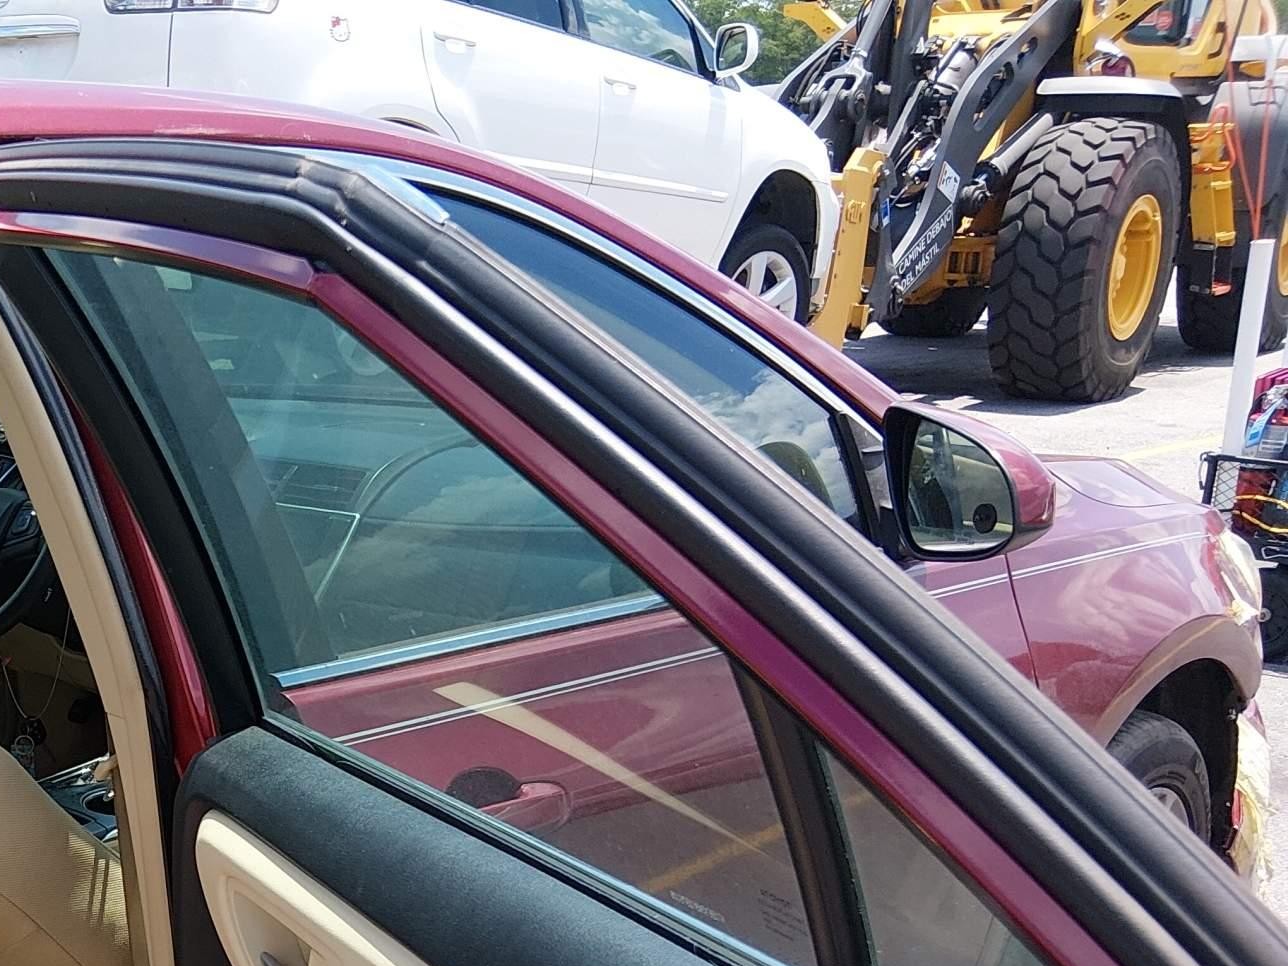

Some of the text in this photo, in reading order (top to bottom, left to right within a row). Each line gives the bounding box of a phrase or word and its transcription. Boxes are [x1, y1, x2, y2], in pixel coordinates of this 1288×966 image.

[898, 209, 952, 274] CAMINE DEBAJO
[901, 271, 915, 289] DEL
